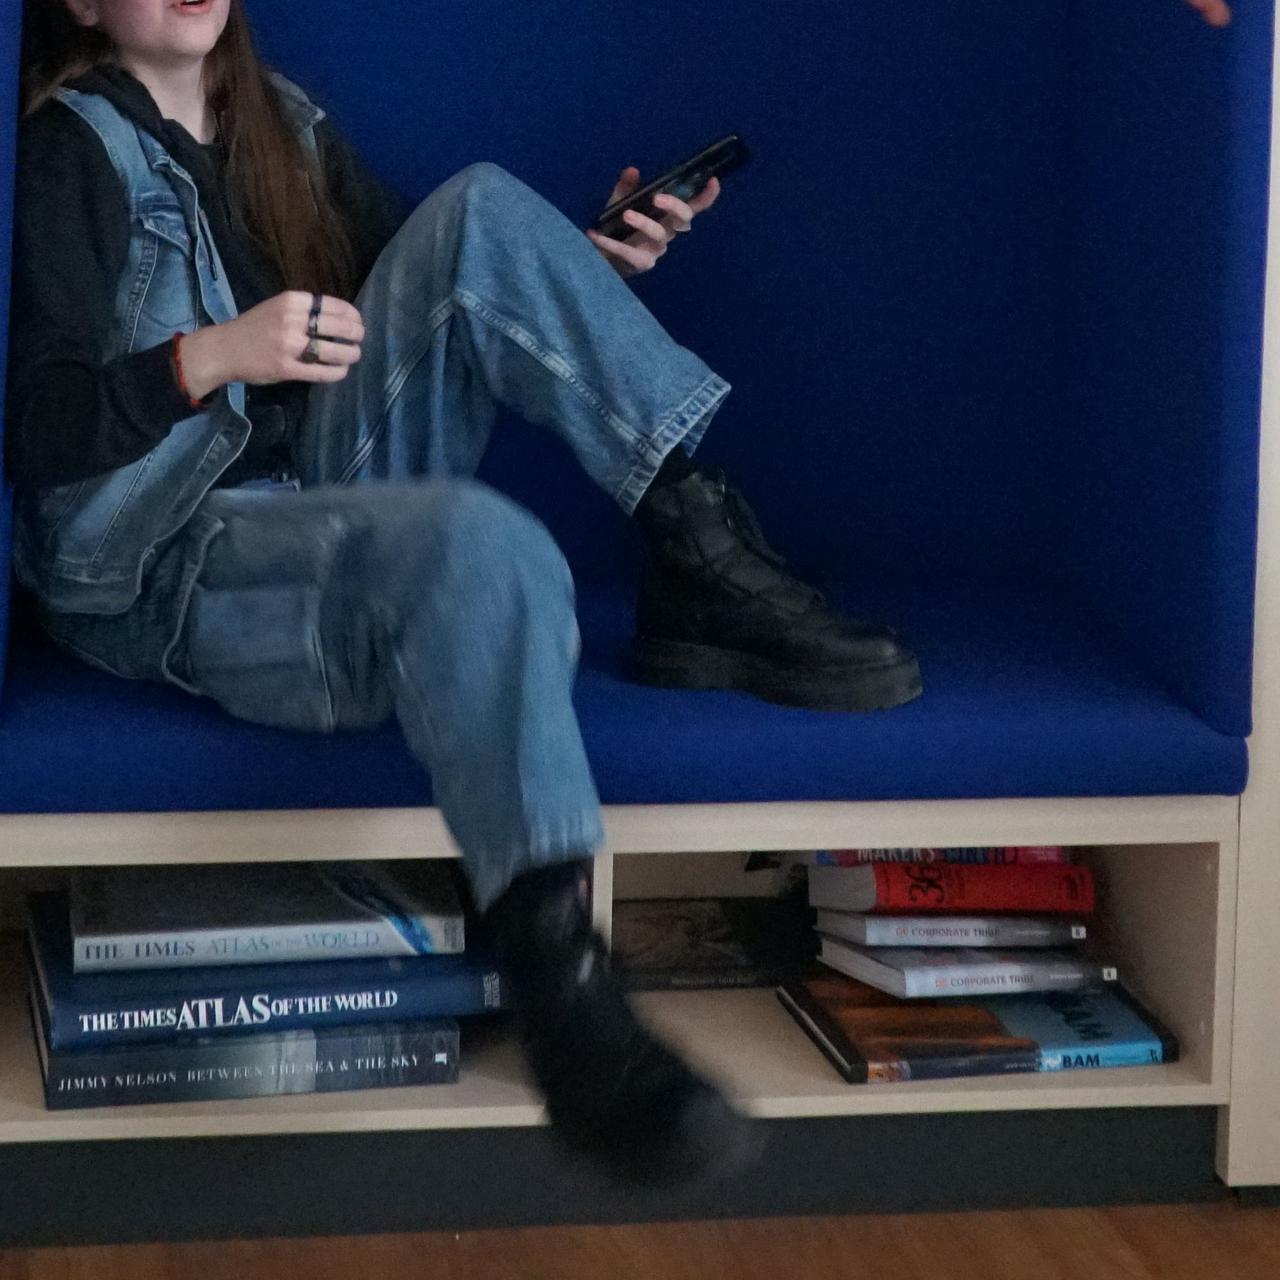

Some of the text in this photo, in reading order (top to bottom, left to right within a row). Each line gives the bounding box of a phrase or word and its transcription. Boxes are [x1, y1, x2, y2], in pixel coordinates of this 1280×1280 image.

[912, 927, 970, 937] CORPORATE
[973, 927, 1000, 936] TRIBE
[85, 943, 124, 960] THE
[135, 941, 195, 958] TIMES
[210, 936, 270, 954] ATLAS
[304, 930, 379, 947] WORLD
[950, 977, 1007, 987] CORPORATE
[79, 990, 399, 1032] THE TIMES ATLAS OF THE WORLD
[1063, 1054, 1100, 1068] BAM
[58, 1076, 107, 1091] JIMMY
[115, 1071, 177, 1087] NELSON
[187, 1065, 263, 1082] BETWEEN
[306, 1060, 334, 1073] SEA
[340, 1059, 348, 1070] &
[354, 1056, 386, 1070] THE
[392, 1054, 420, 1067] SKY
